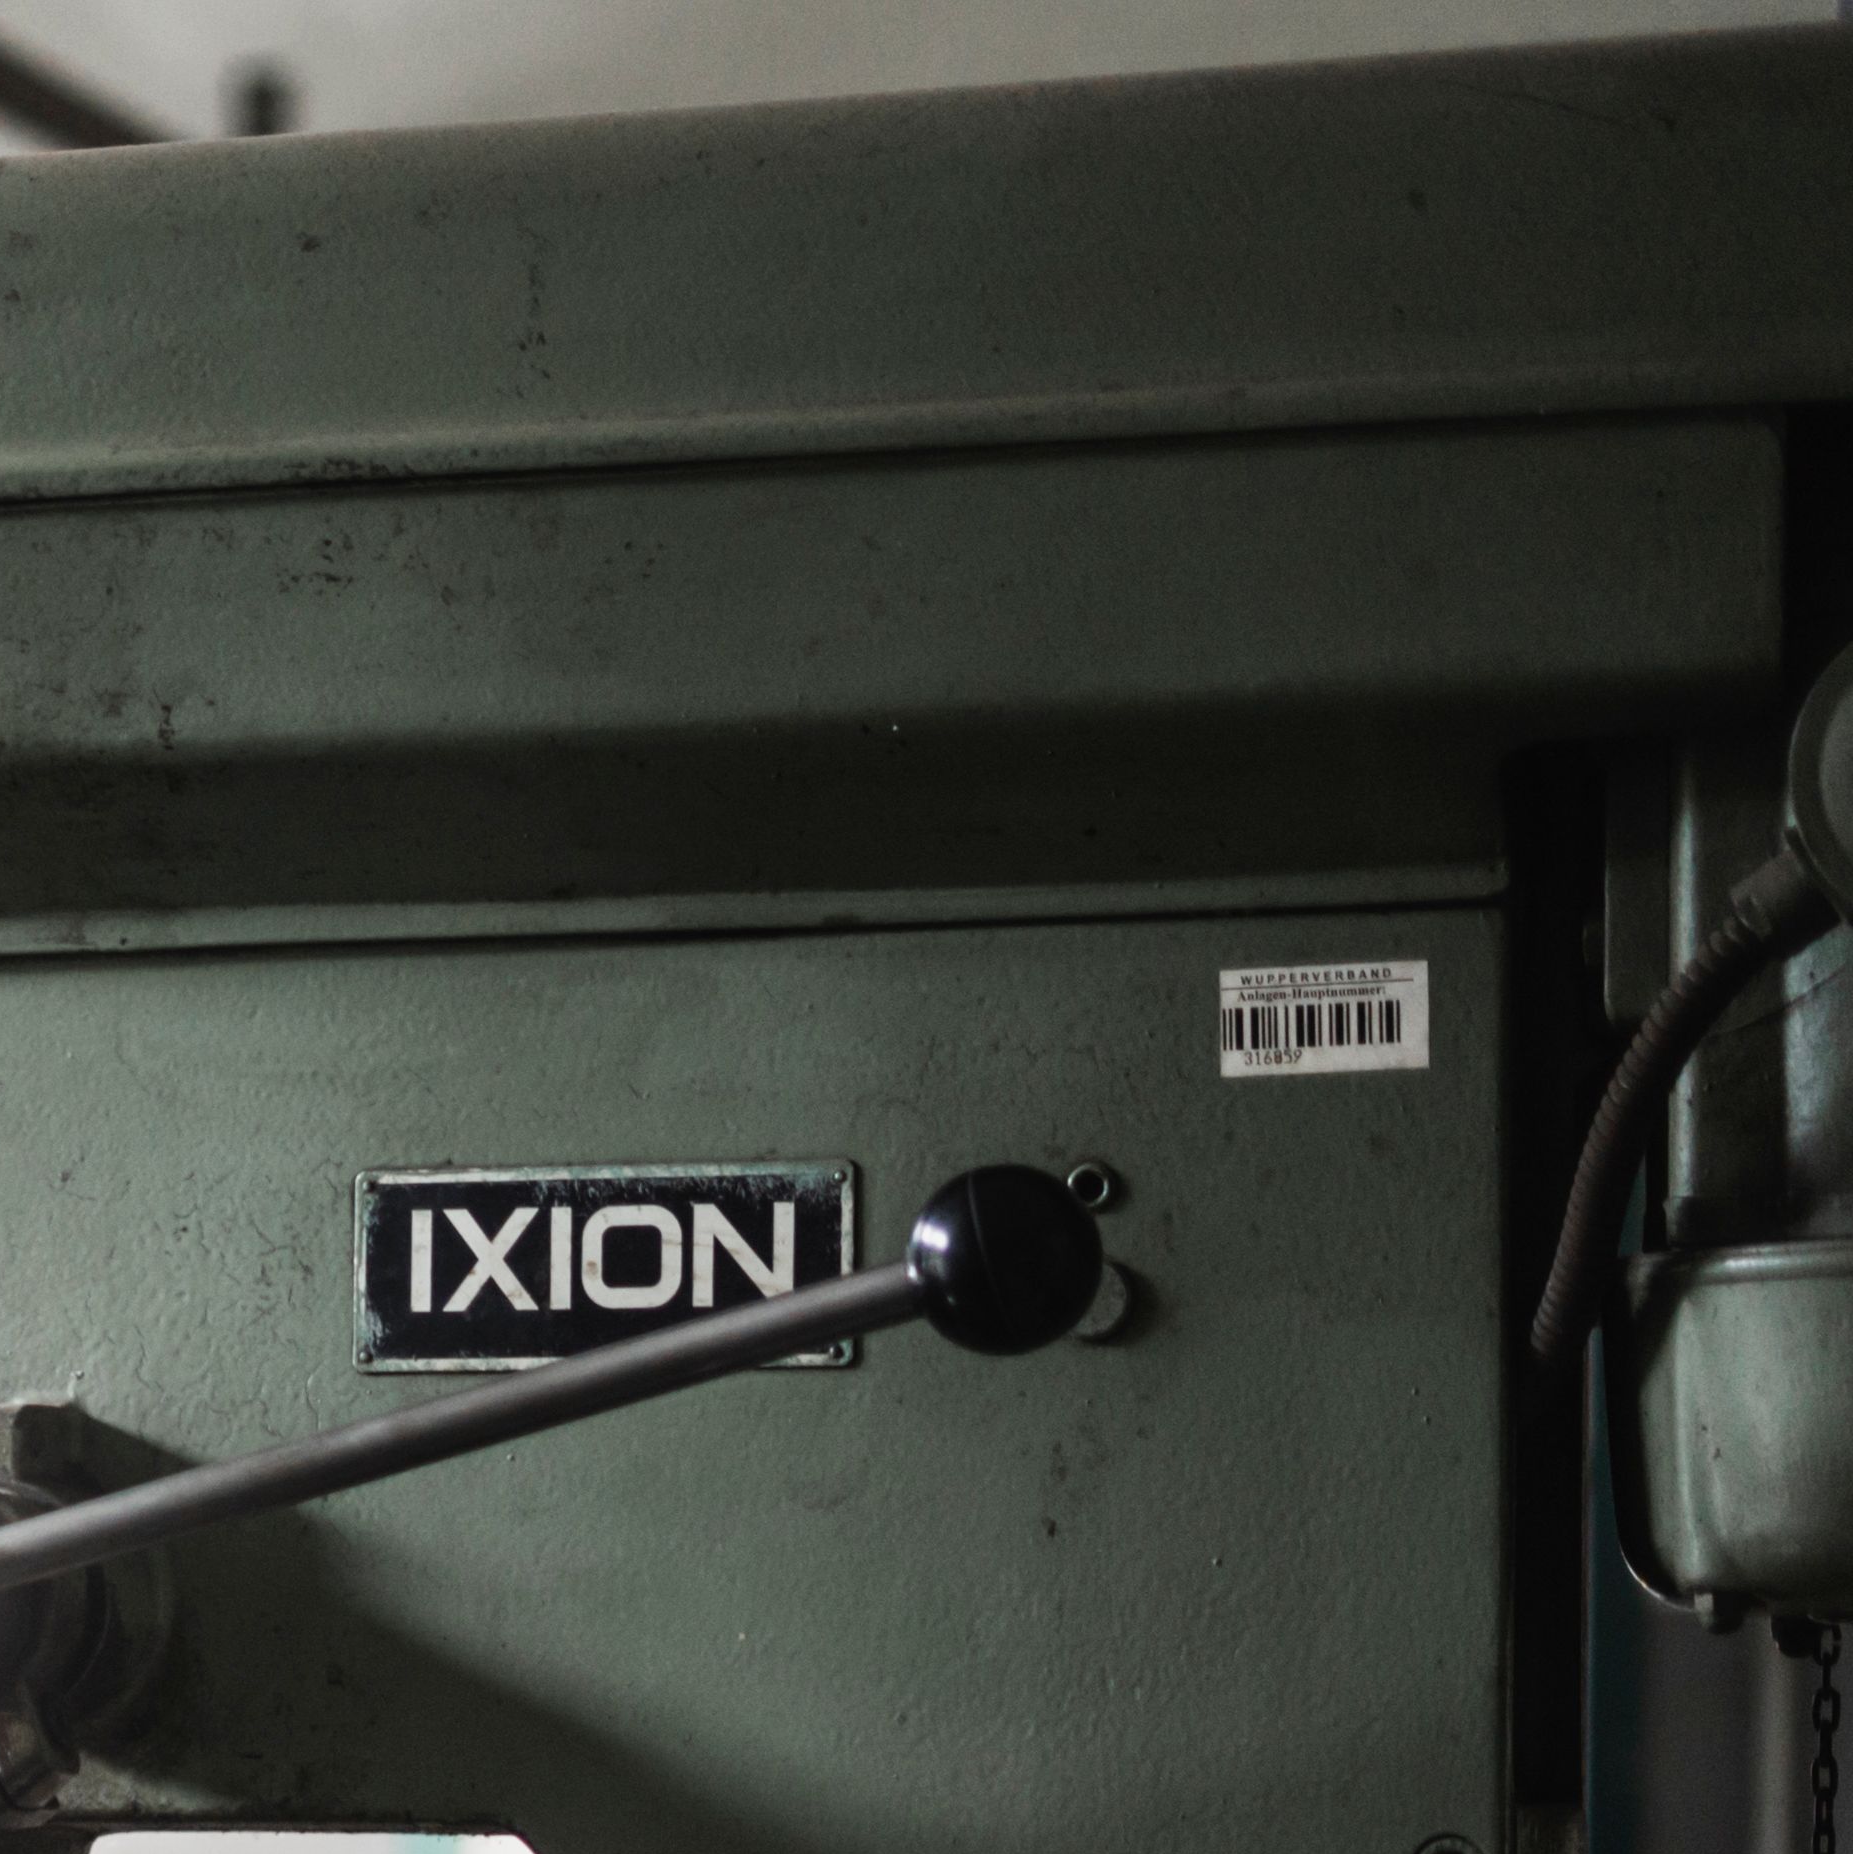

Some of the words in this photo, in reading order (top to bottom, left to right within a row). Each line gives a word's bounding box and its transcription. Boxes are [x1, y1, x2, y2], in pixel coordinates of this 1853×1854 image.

[1240, 968, 1392, 986] WUPPERVERBAND
[1244, 1050, 1303, 1066] 316859
[409, 1201, 795, 1314] IXION
